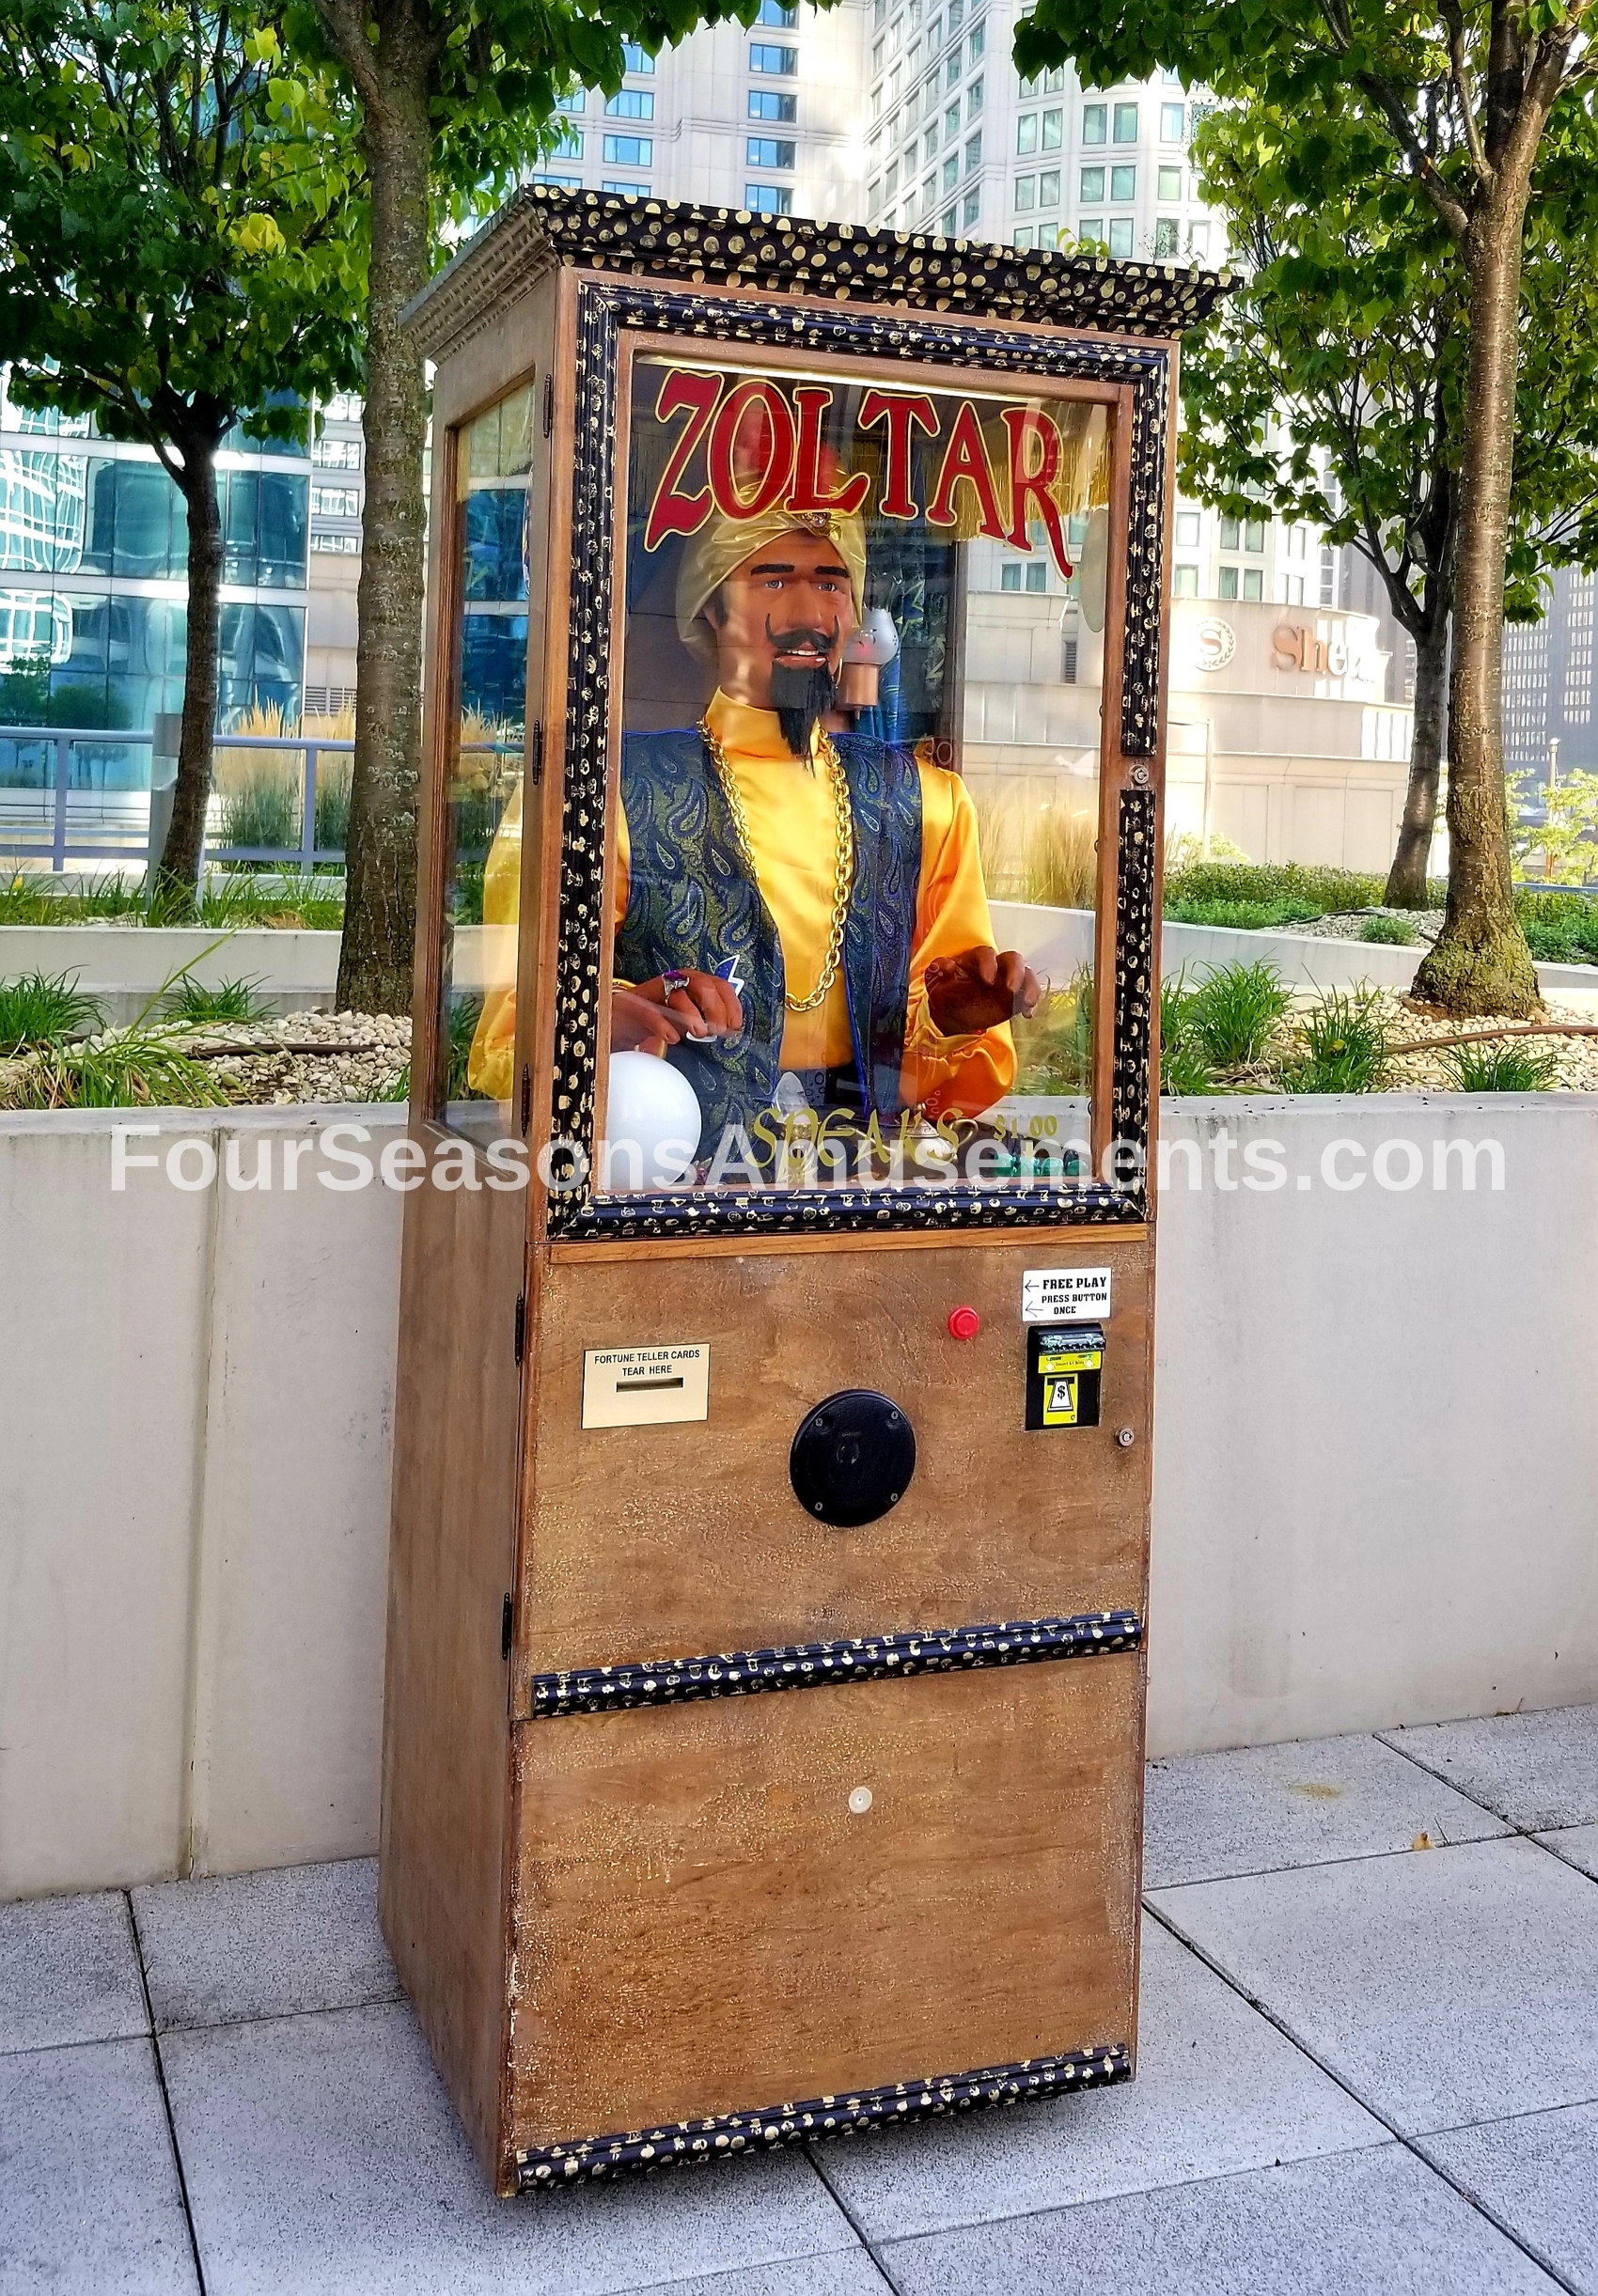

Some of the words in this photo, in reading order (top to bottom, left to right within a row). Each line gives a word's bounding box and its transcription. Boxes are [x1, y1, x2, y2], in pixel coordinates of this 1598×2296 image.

[644, 368, 1075, 584] ZOLTAR
[744, 1108, 964, 1168] SPEAKS
[1042, 1278, 1073, 1290] FREE
[1075, 1276, 1107, 1289] PLAY
[1041, 1294, 1070, 1304] PRESS
[1072, 1292, 1107, 1303] BUTTON
[1053, 1305, 1076, 1315] ONCE
[594, 1352, 634, 1365] FORTUNE
[637, 1351, 669, 1362] TELLER
[670, 1349, 700, 1360] CARDS
[622, 1366, 645, 1376] TEAR
[649, 1365, 672, 1375] HERE
